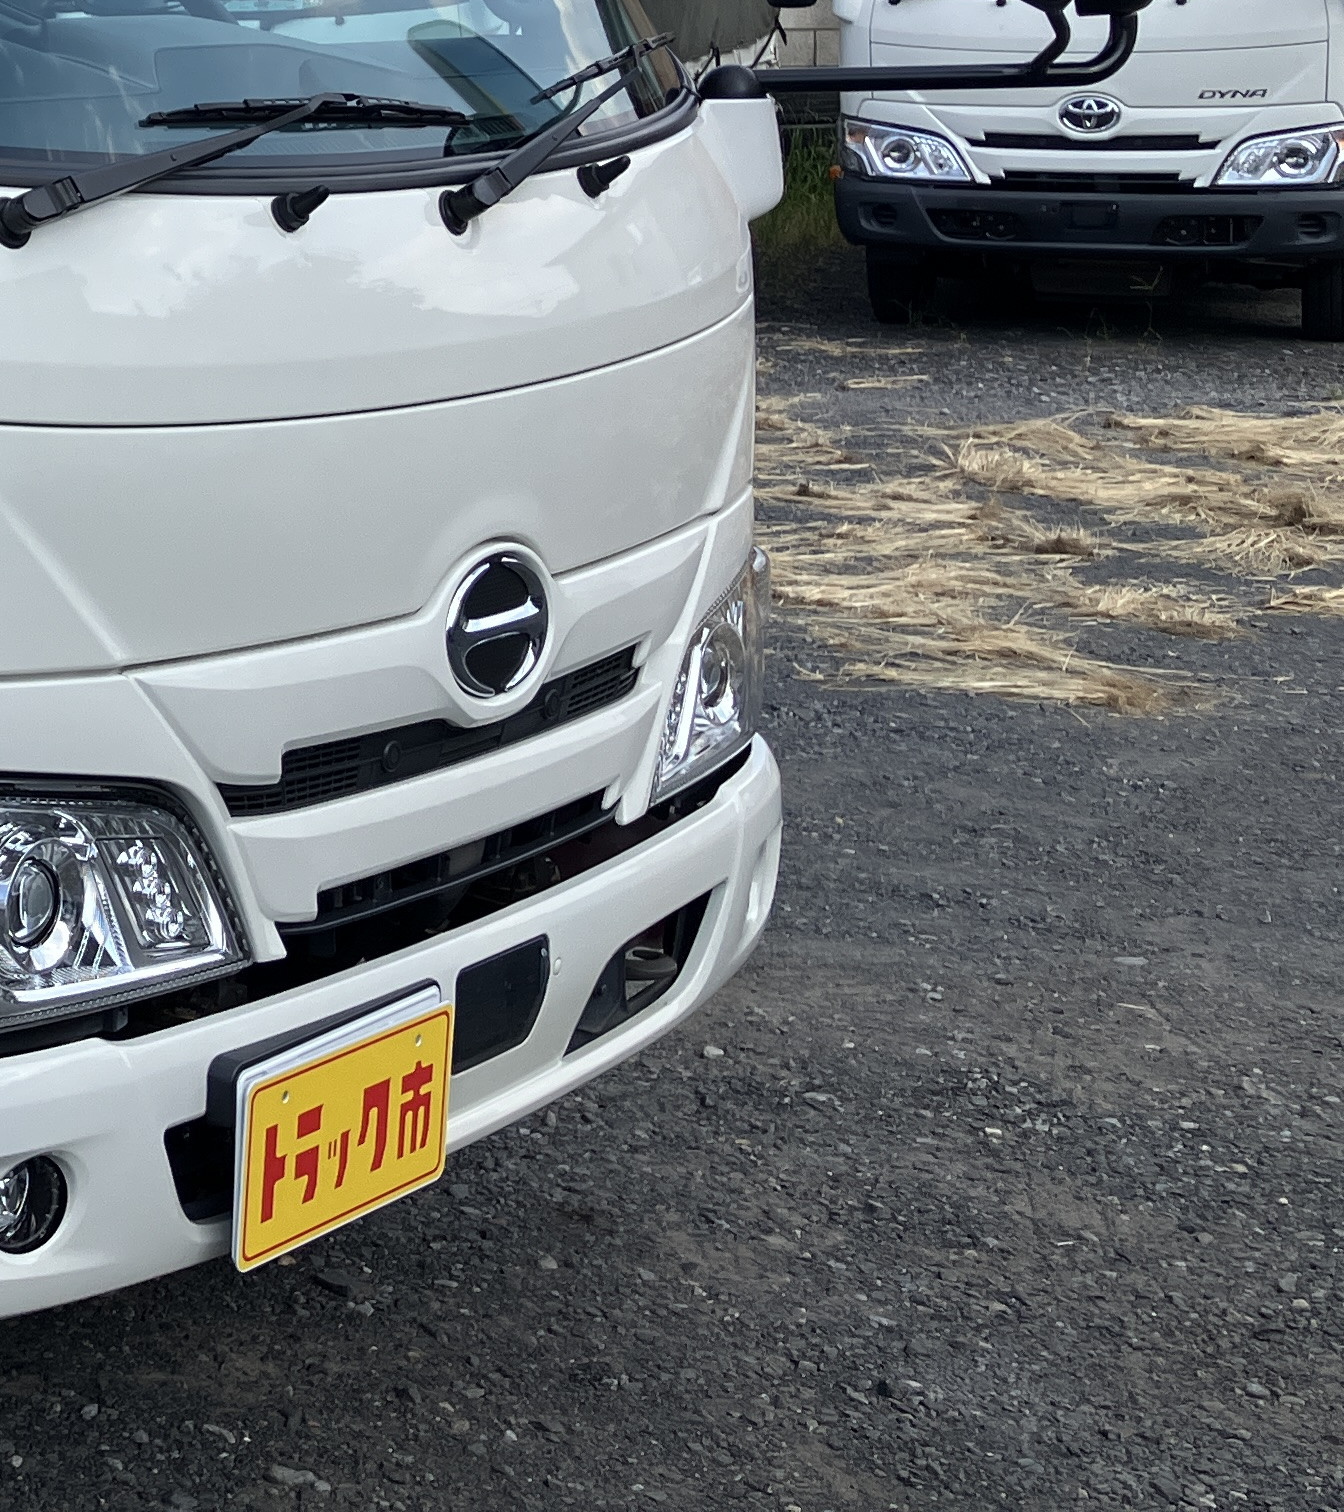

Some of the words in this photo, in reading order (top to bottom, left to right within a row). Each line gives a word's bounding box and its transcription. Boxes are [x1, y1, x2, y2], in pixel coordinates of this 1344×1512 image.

[1197, 88, 1268, 100] DYNA
[260, 1060, 434, 1224] トラック市
